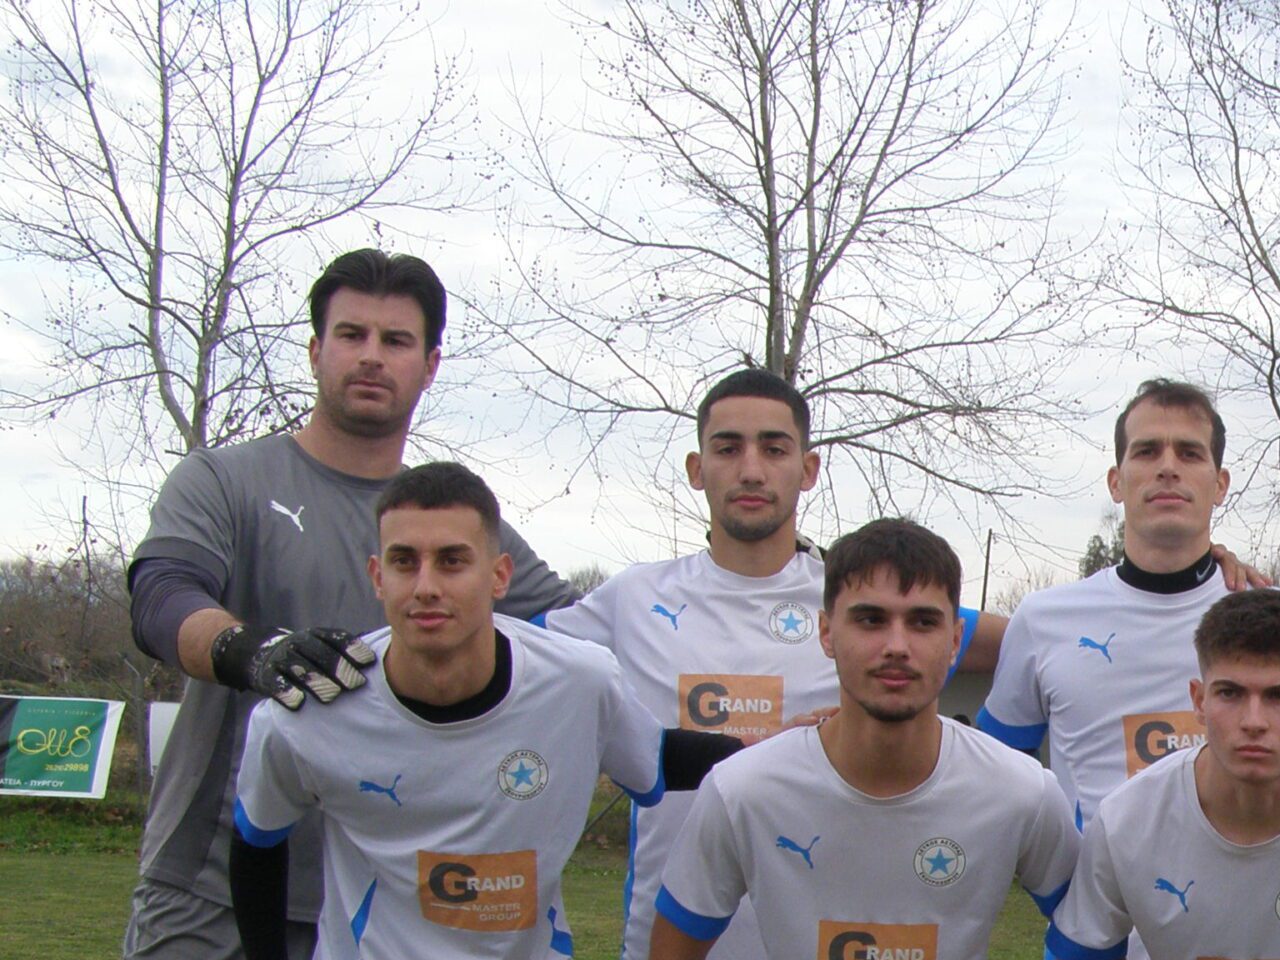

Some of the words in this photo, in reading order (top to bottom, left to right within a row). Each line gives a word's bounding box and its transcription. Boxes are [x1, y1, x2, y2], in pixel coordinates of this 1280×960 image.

[687, 682, 772, 727] GRAND
[724, 726, 768, 736] MASTER
[1134, 720, 1207, 765] GRAN
[428, 862, 526, 904] GRAND
[472, 902, 521, 912] MASTER
[479, 912, 521, 922] GROUP
